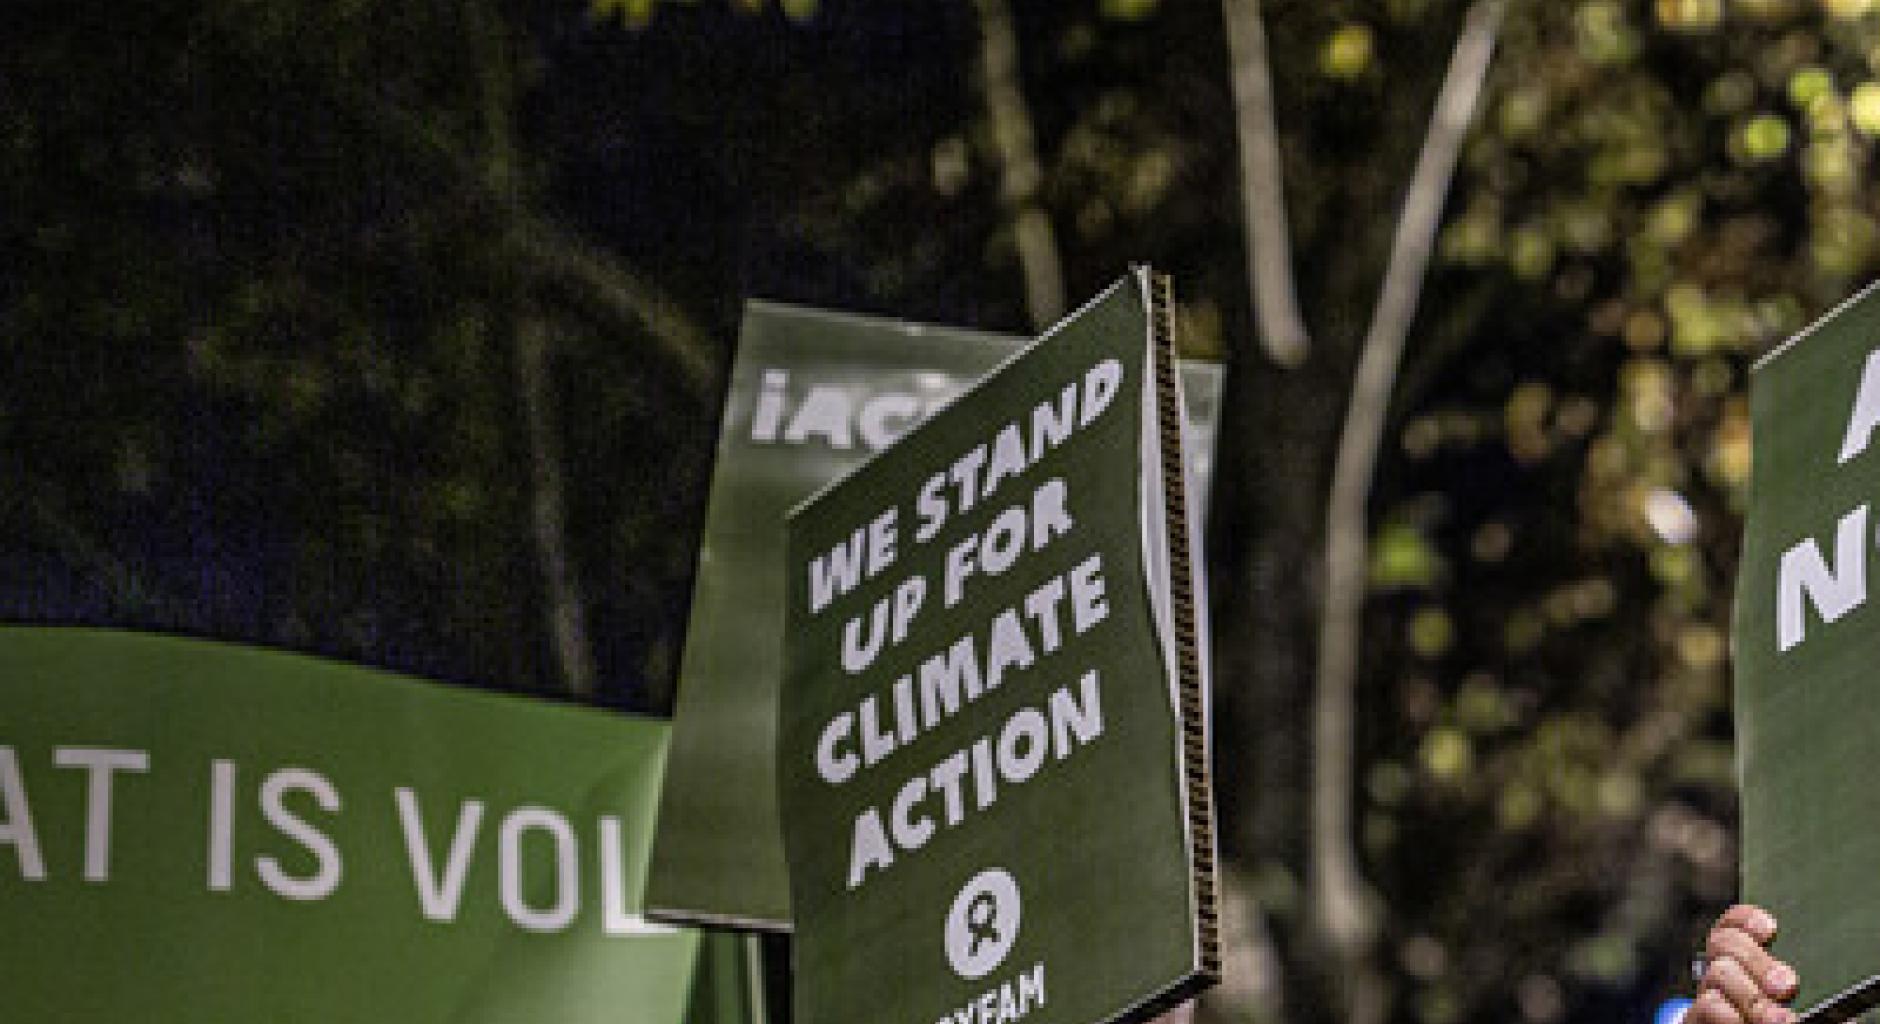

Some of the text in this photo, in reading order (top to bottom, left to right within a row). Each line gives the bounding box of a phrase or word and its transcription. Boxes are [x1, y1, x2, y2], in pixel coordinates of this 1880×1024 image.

[808, 358, 1125, 614] WE STAND
[840, 480, 1073, 674] UP FOR
[815, 551, 1110, 784] CLIMATE
[207, 758, 343, 901] IS
[395, 786, 682, 936] VOL
[846, 668, 1105, 890] ACTION
